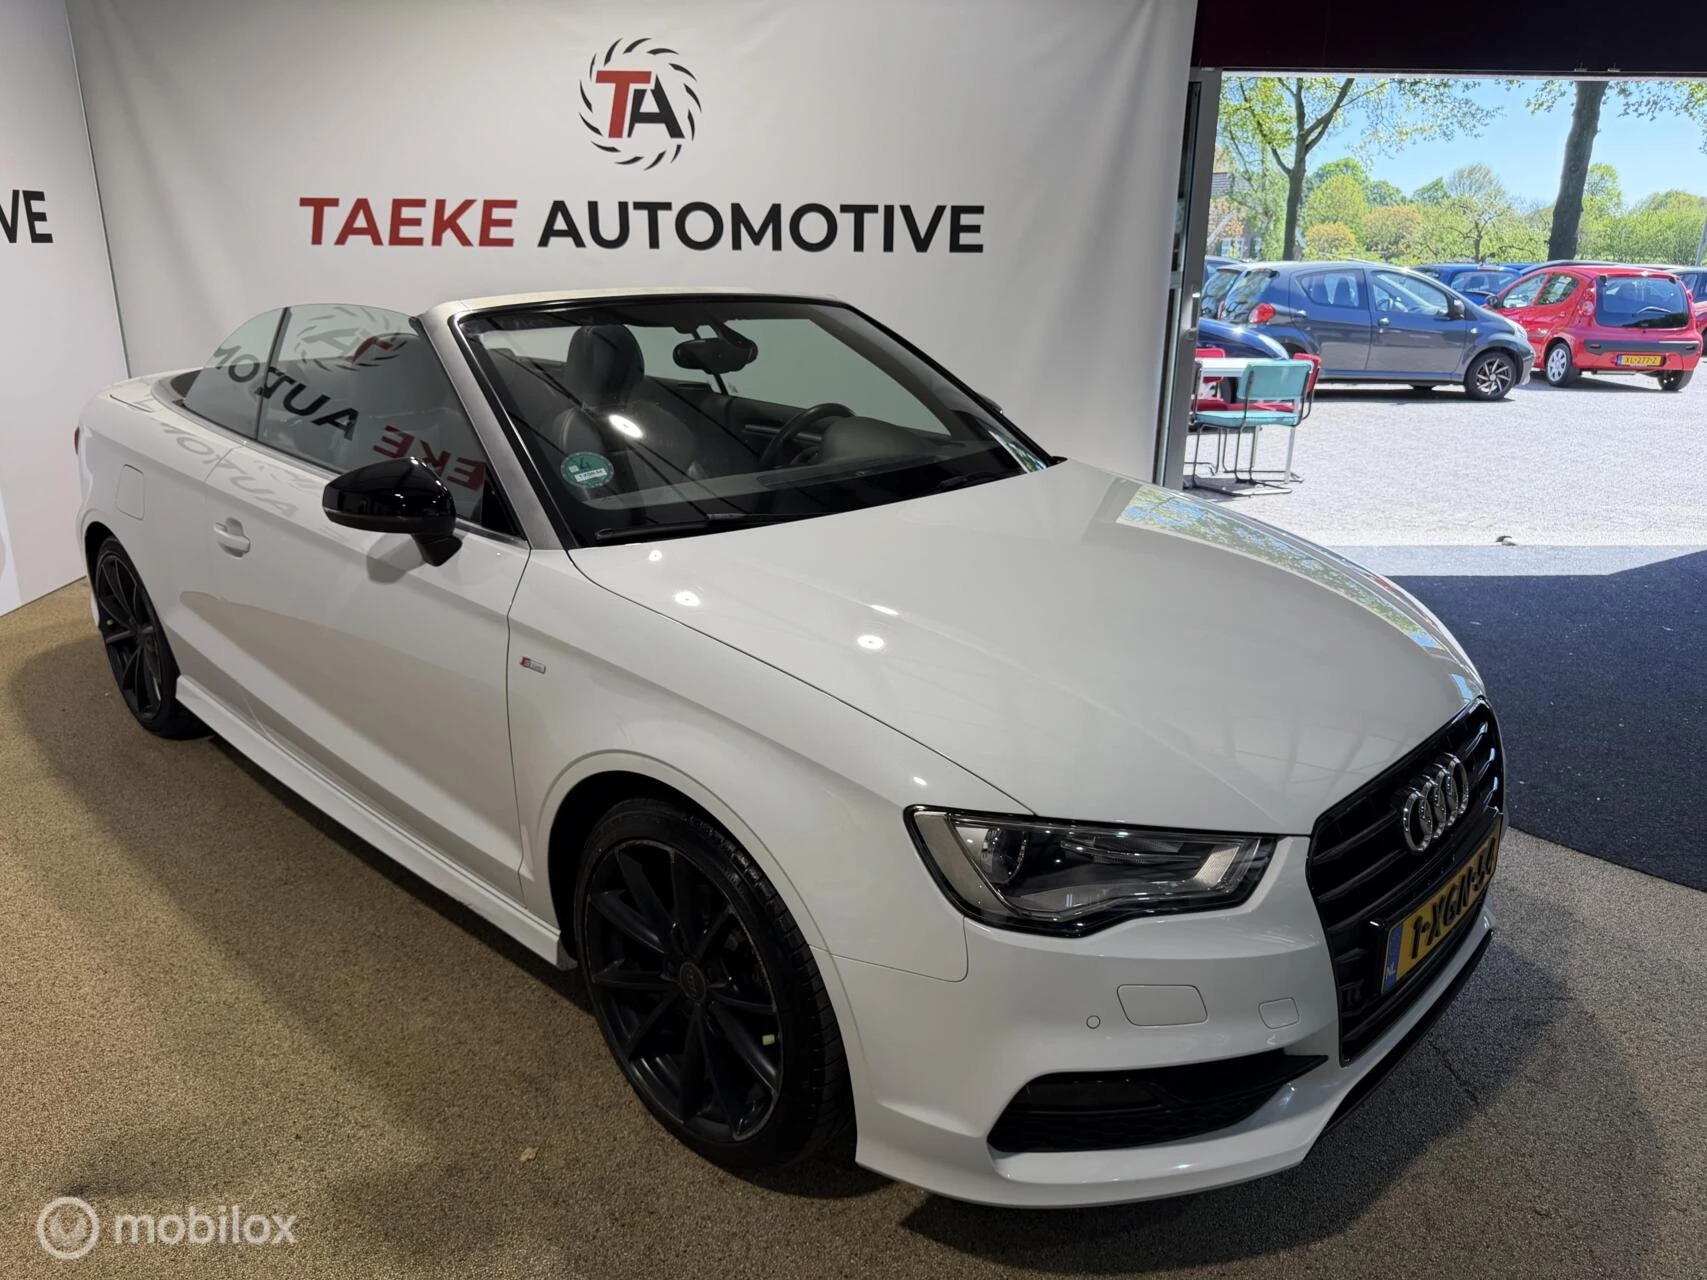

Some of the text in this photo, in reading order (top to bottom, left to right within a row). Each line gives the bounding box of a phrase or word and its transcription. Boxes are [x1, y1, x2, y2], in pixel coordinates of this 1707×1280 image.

[595, 69, 686, 139] TA
[299, 196, 985, 254] TAEKE AUTOMOTIVE
